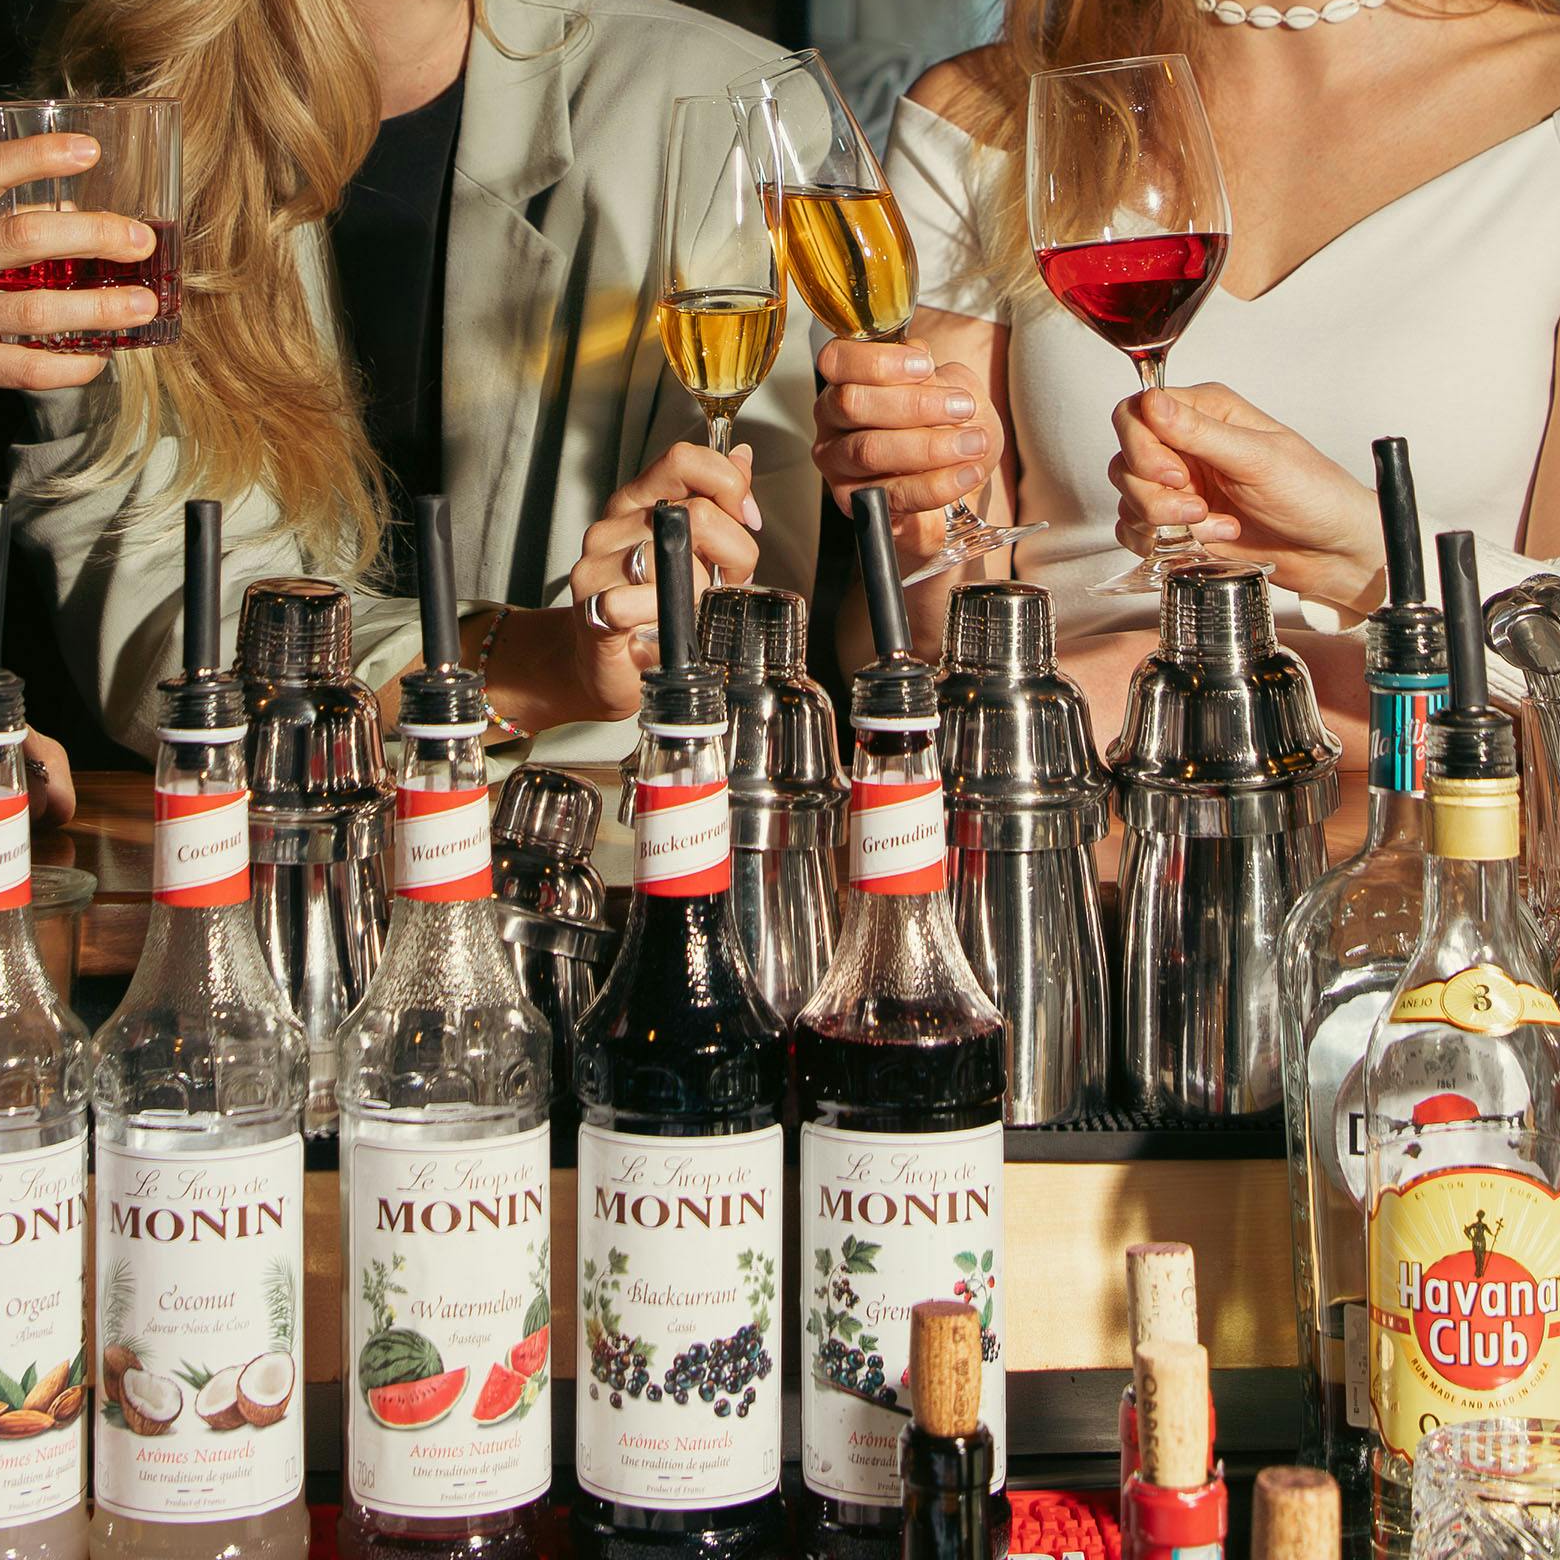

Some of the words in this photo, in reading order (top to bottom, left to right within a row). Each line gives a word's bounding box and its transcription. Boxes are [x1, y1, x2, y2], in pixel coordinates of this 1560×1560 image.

[177, 830, 243, 863] Coconut
[412, 826, 489, 862] Watermelo
[862, 821, 940, 855] Grenadine
[1400, 997, 1432, 1008] AÑEJO
[1473, 984, 1492, 1011] 3
[9, 1167, 66, 1202] Sirop
[125, 1169, 160, 1199] Le
[168, 1167, 239, 1203] Sirop
[244, 1175, 270, 1196] de
[396, 1163, 435, 1192] Le
[444, 1158, 513, 1193] Sirop
[513, 1162, 535, 1182] de
[610, 1154, 647, 1184] Le
[652, 1155, 721, 1190] Sirop
[728, 1164, 751, 1184] de
[835, 1151, 874, 1184] Le
[880, 1152, 947, 1192] Sirop
[952, 1162, 976, 1182] de
[110, 1196, 285, 1242] MONIN
[377, 1183, 543, 1234] MONIN
[594, 1186, 767, 1229] MONIN
[818, 1183, 991, 1227] MONIN
[5, 1291, 61, 1320] Orgeat
[158, 1285, 240, 1311] Coconut
[410, 1287, 524, 1320] Watermelon
[626, 1278, 737, 1307] Blackcurrant
[1397, 1261, 1558, 1317] Havana
[143, 1317, 181, 1335] Saveur
[183, 1316, 210, 1335] Noix
[212, 1318, 226, 1331] de
[227, 1316, 251, 1331] Coco
[667, 1318, 697, 1334] Cassis
[866, 1293, 911, 1328] Gren
[11, 1324, 54, 1346] Almond
[1429, 1318, 1529, 1367] Club
[1410, 1358, 1428, 1382] RUM
[1430, 1382, 1455, 1403] MADE
[1461, 1399, 1483, 1409] AND
[1488, 1396, 1515, 1409] AGED
[1530, 1362, 1550, 1388] CUBA
[136, 1447, 188, 1463] Arômes
[194, 1440, 256, 1464] Naturels
[410, 1442, 464, 1458] Arômes
[469, 1431, 522, 1457] Naturels
[618, 1431, 670, 1450] Arômes
[675, 1430, 733, 1451] Naturels
[3, 1472, 42, 1487] tradition
[139, 1471, 157, 1482] Une
[160, 1470, 203, 1483] tradition
[206, 1470, 216, 1482] de
[219, 1466, 253, 1483] qualité
[357, 1460, 375, 1489] 70cl
[412, 1466, 431, 1477] Une
[435, 1466, 478, 1478] tradition
[480, 1463, 491, 1473] de
[492, 1457, 520, 1475] qualité
[620, 1454, 639, 1467] Une
[641, 1455, 683, 1470] tradition
[686, 1458, 697, 1469] de
[699, 1456, 731, 1472] qualité
